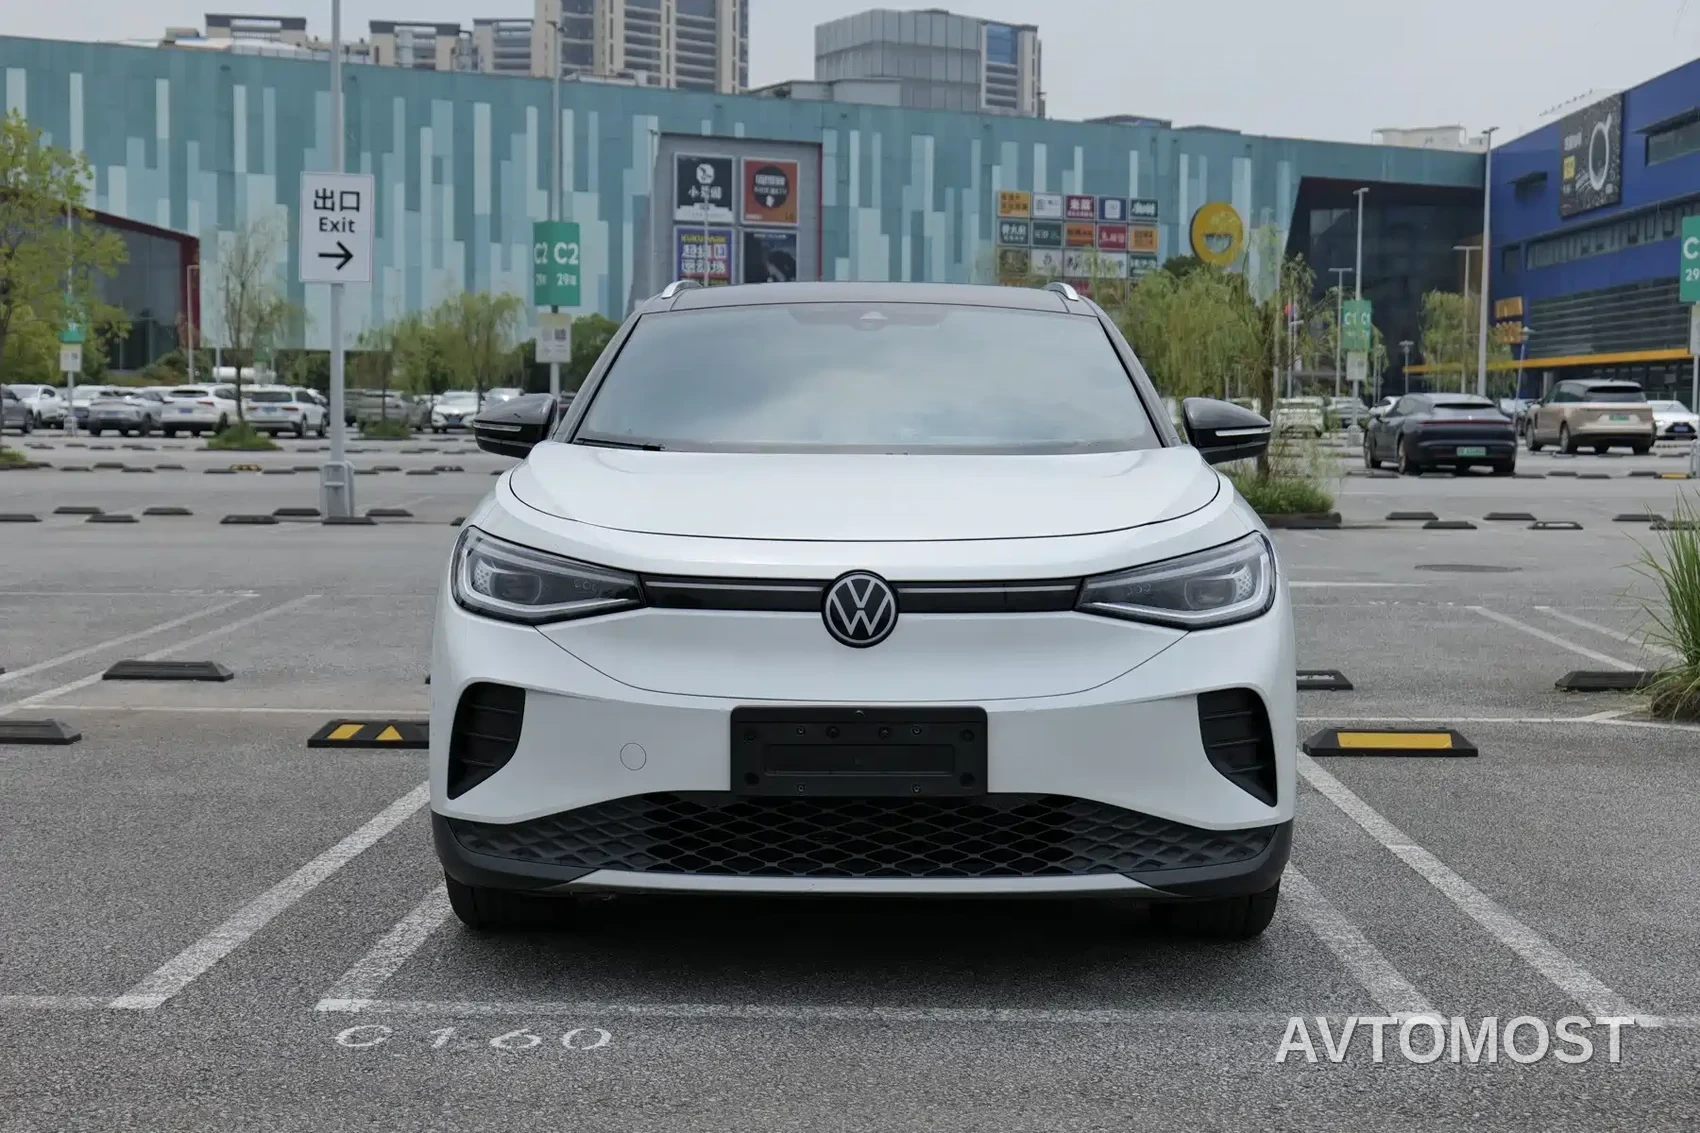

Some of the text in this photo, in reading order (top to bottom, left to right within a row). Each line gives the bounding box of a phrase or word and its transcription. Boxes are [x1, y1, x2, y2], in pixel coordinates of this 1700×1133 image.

[313, 188, 360, 212] 出口
[319, 217, 355, 233] Exit
[554, 241, 579, 265] C2
